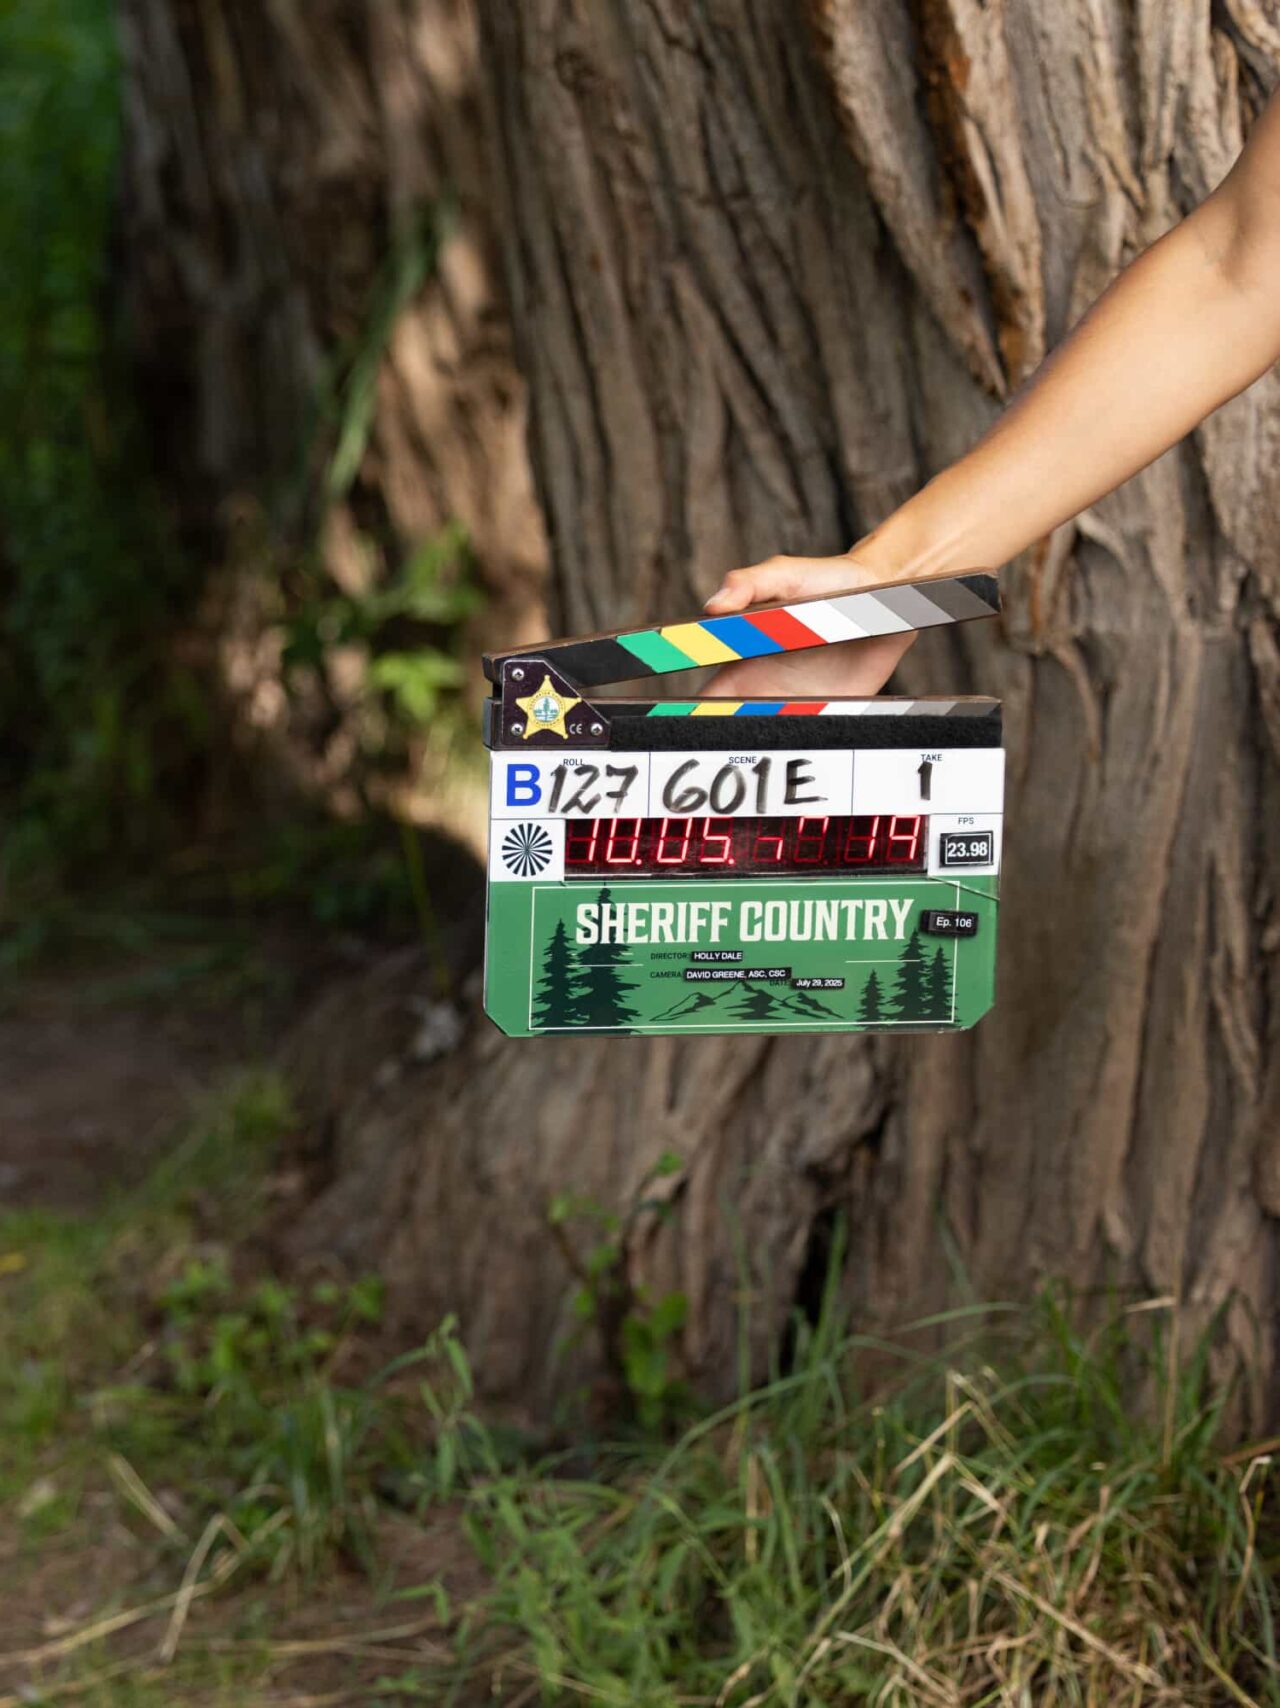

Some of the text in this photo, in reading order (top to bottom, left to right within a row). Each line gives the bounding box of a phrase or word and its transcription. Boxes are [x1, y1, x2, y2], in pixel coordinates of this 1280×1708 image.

[569, 723, 582, 734] CE
[563, 758, 584, 766] ROLL
[728, 756, 757, 764] SCENE
[921, 753, 942, 762] TAKE
[506, 763, 542, 806] B
[917, 761, 932, 801] 1
[548, 764, 638, 814] 127
[958, 817, 974, 825] FPS
[947, 841, 988, 857] 23.98
[576, 898, 914, 944] SHERIFF COUNTRY
[936, 916, 972, 928] Ep. 106
[694, 952, 720, 960] HOLLY
[721, 952, 742, 960] DALE
[686, 971, 710, 979] DAVID
[712, 970, 747, 979] GREENE,
[748, 970, 767, 978] ASC,
[768, 969, 786, 977] CSC
[796, 979, 811, 988] July
[812, 979, 824, 987] 29,
[824, 979, 843, 987] 2025
